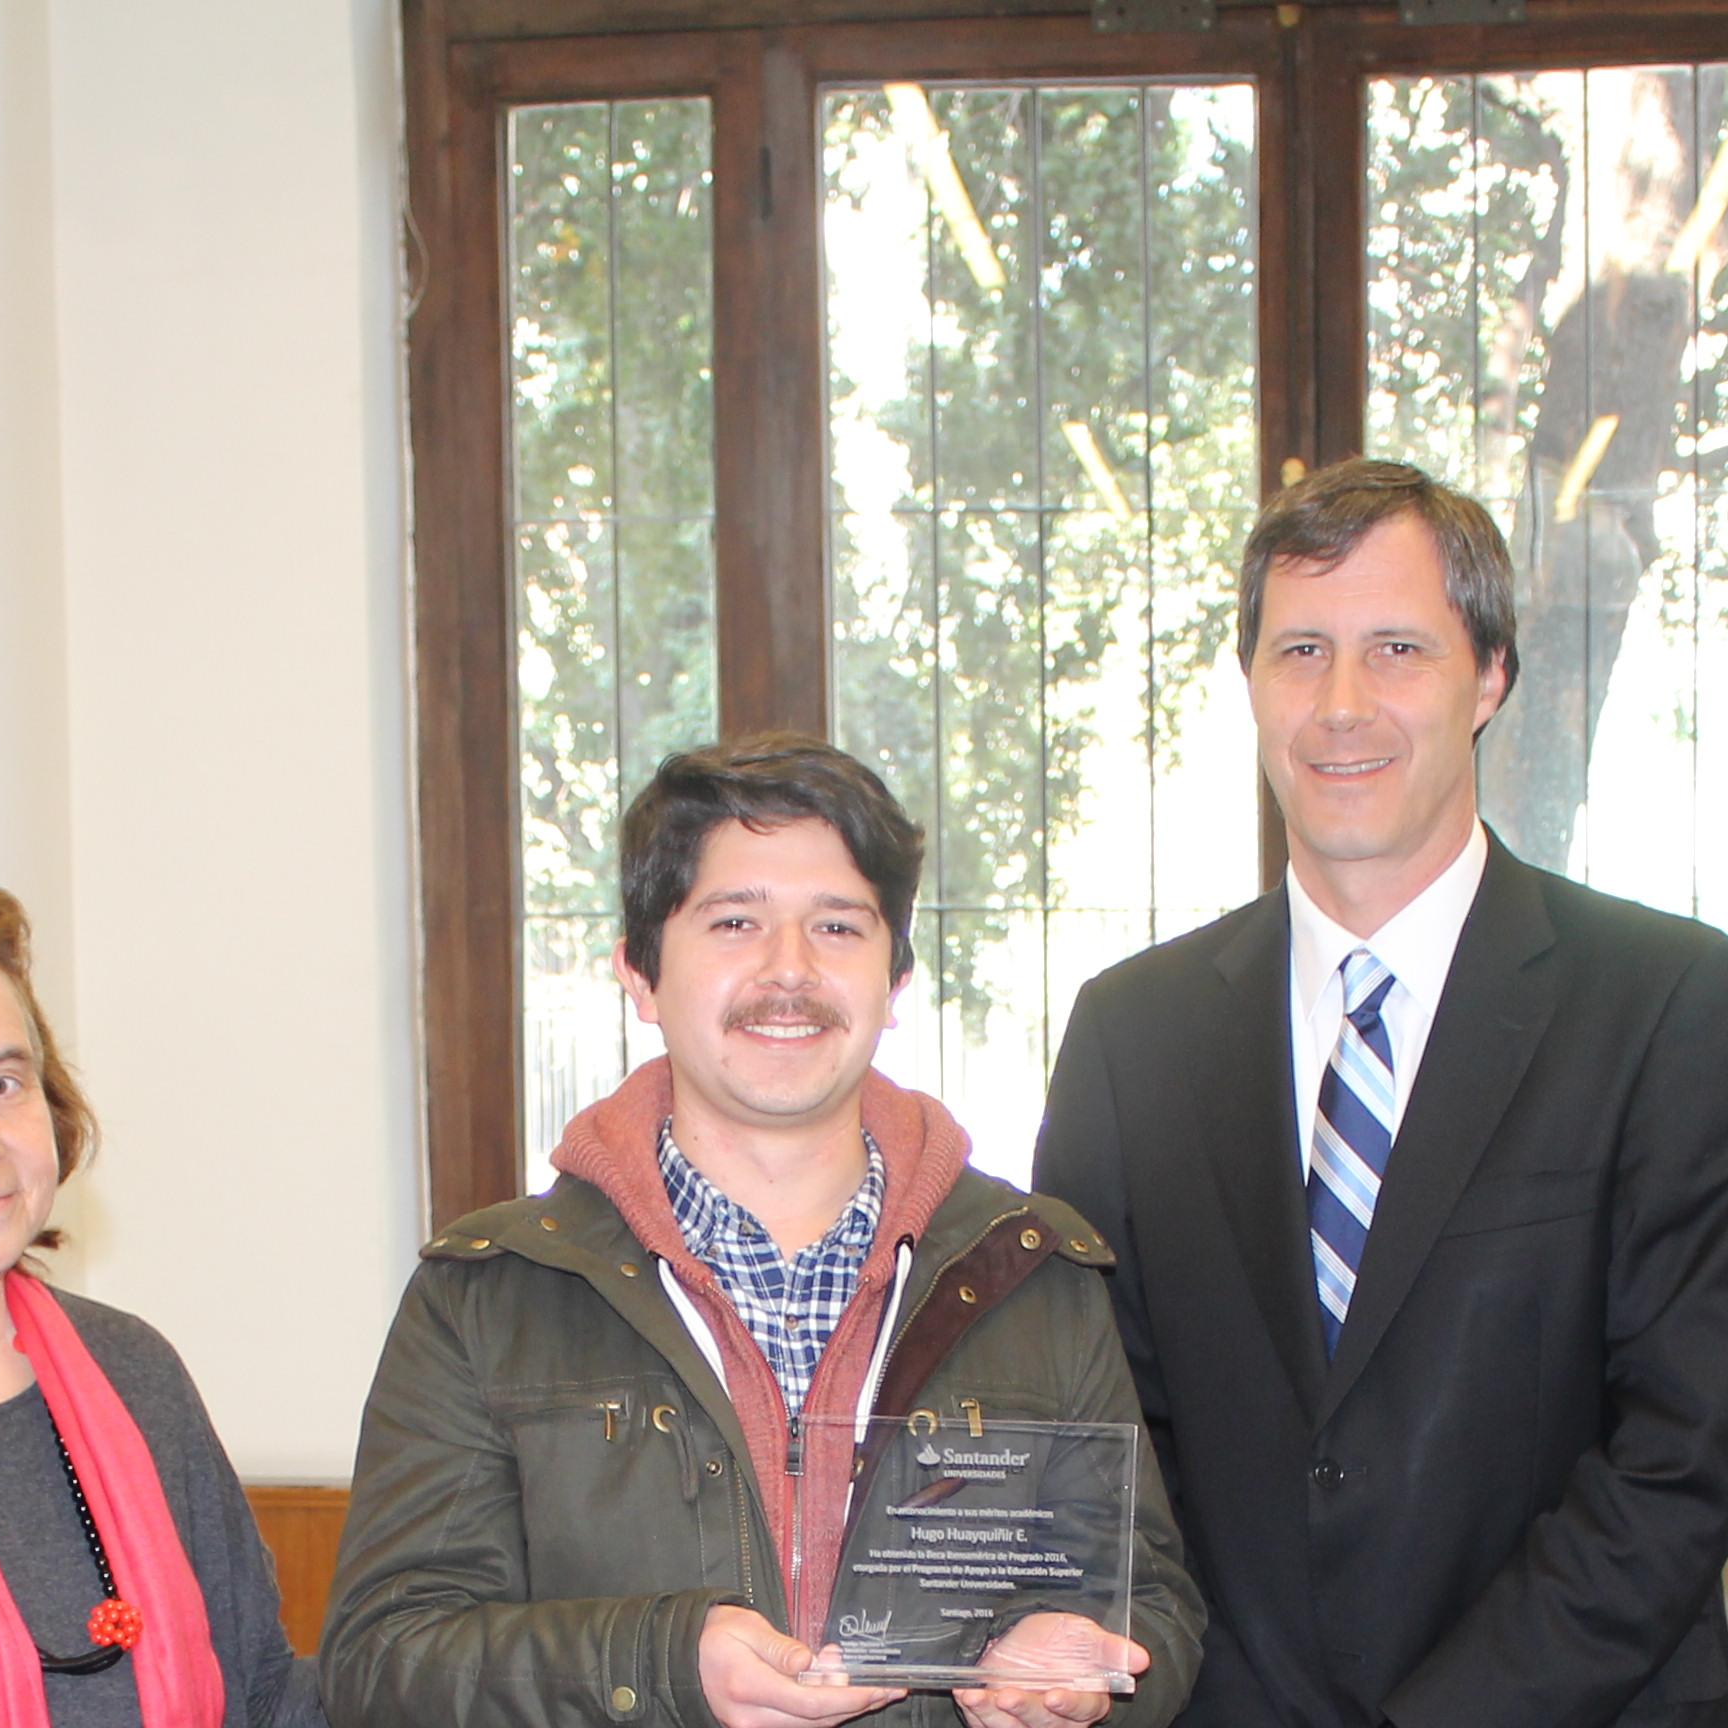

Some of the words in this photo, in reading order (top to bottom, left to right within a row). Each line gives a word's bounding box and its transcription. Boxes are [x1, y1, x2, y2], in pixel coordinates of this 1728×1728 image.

[943, 1448, 1029, 1466] Santander
[943, 1470, 1006, 1479] UNIVERSIDADES
[911, 1526, 944, 1543] Hugo
[1016, 1529, 1027, 1542] E.
[882, 1549, 916, 1559] obtenido
[918, 1550, 925, 1559] la
[926, 1550, 946, 1560] Beca
[997, 1552, 1008, 1561] de
[1008, 1552, 1043, 1563] Pregrado
[1044, 1553, 1068, 1563] 2016,
[888, 1565, 901, 1574] por
[903, 1564, 911, 1573] el
[912, 1564, 951, 1575] Programa
[952, 1565, 963, 1574] de
[964, 1565, 990, 1576] Apoyo
[998, 1566, 1005, 1575] la
[1007, 1566, 1048, 1576] Educación
[1049, 1568, 1084, 1577] Superior
[920, 1578, 959, 1588] Santander
[974, 1608, 994, 1618] 2016
